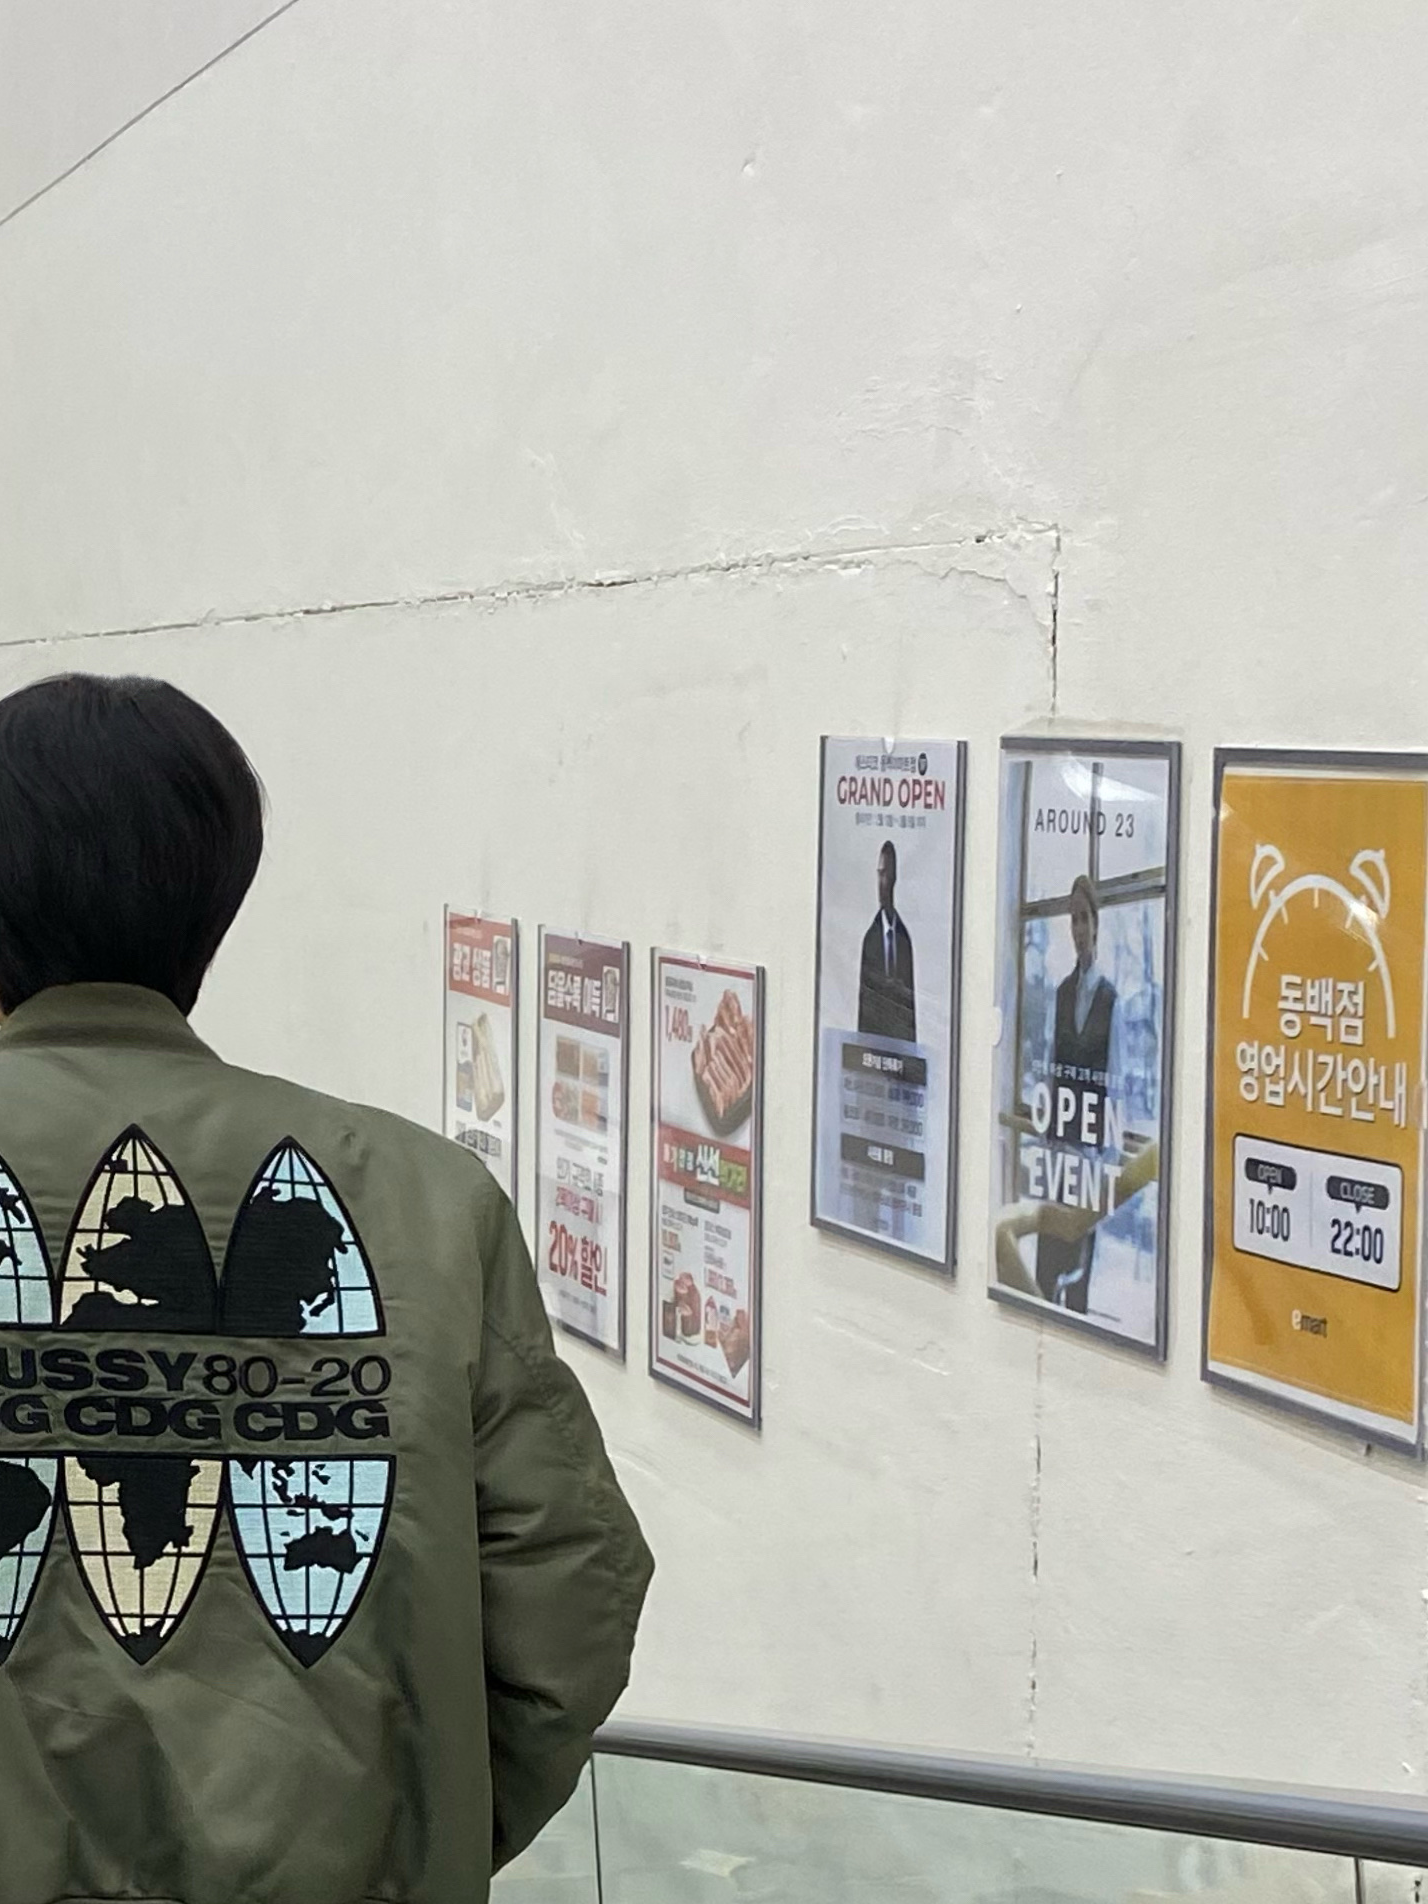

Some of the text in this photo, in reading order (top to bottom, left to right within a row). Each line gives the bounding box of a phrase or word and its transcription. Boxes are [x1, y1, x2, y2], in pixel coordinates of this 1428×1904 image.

[837, 776, 945, 811] GRAND OPEN
[1035, 808, 1135, 838] AROUND 23
[1277, 974, 1364, 1045] 동백점
[1236, 1040, 1407, 1129] 영업시간안내
[1031, 1081, 1123, 1153] OPEN
[1029, 1146, 1122, 1216] EVENT
[1257, 1164, 1282, 1184] OPEN
[1339, 1182, 1375, 1204] CLOSE
[1249, 1198, 1291, 1241] 10:00
[1331, 1218, 1384, 1264] 22:00
[549, 1221, 607, 1296] 20% 할인
[1292, 1309, 1328, 1338] emart
[202, 1354, 392, 1398] 80-20
[64, 1396, 222, 1440] CDG
[232, 1400, 391, 1442] CDG
